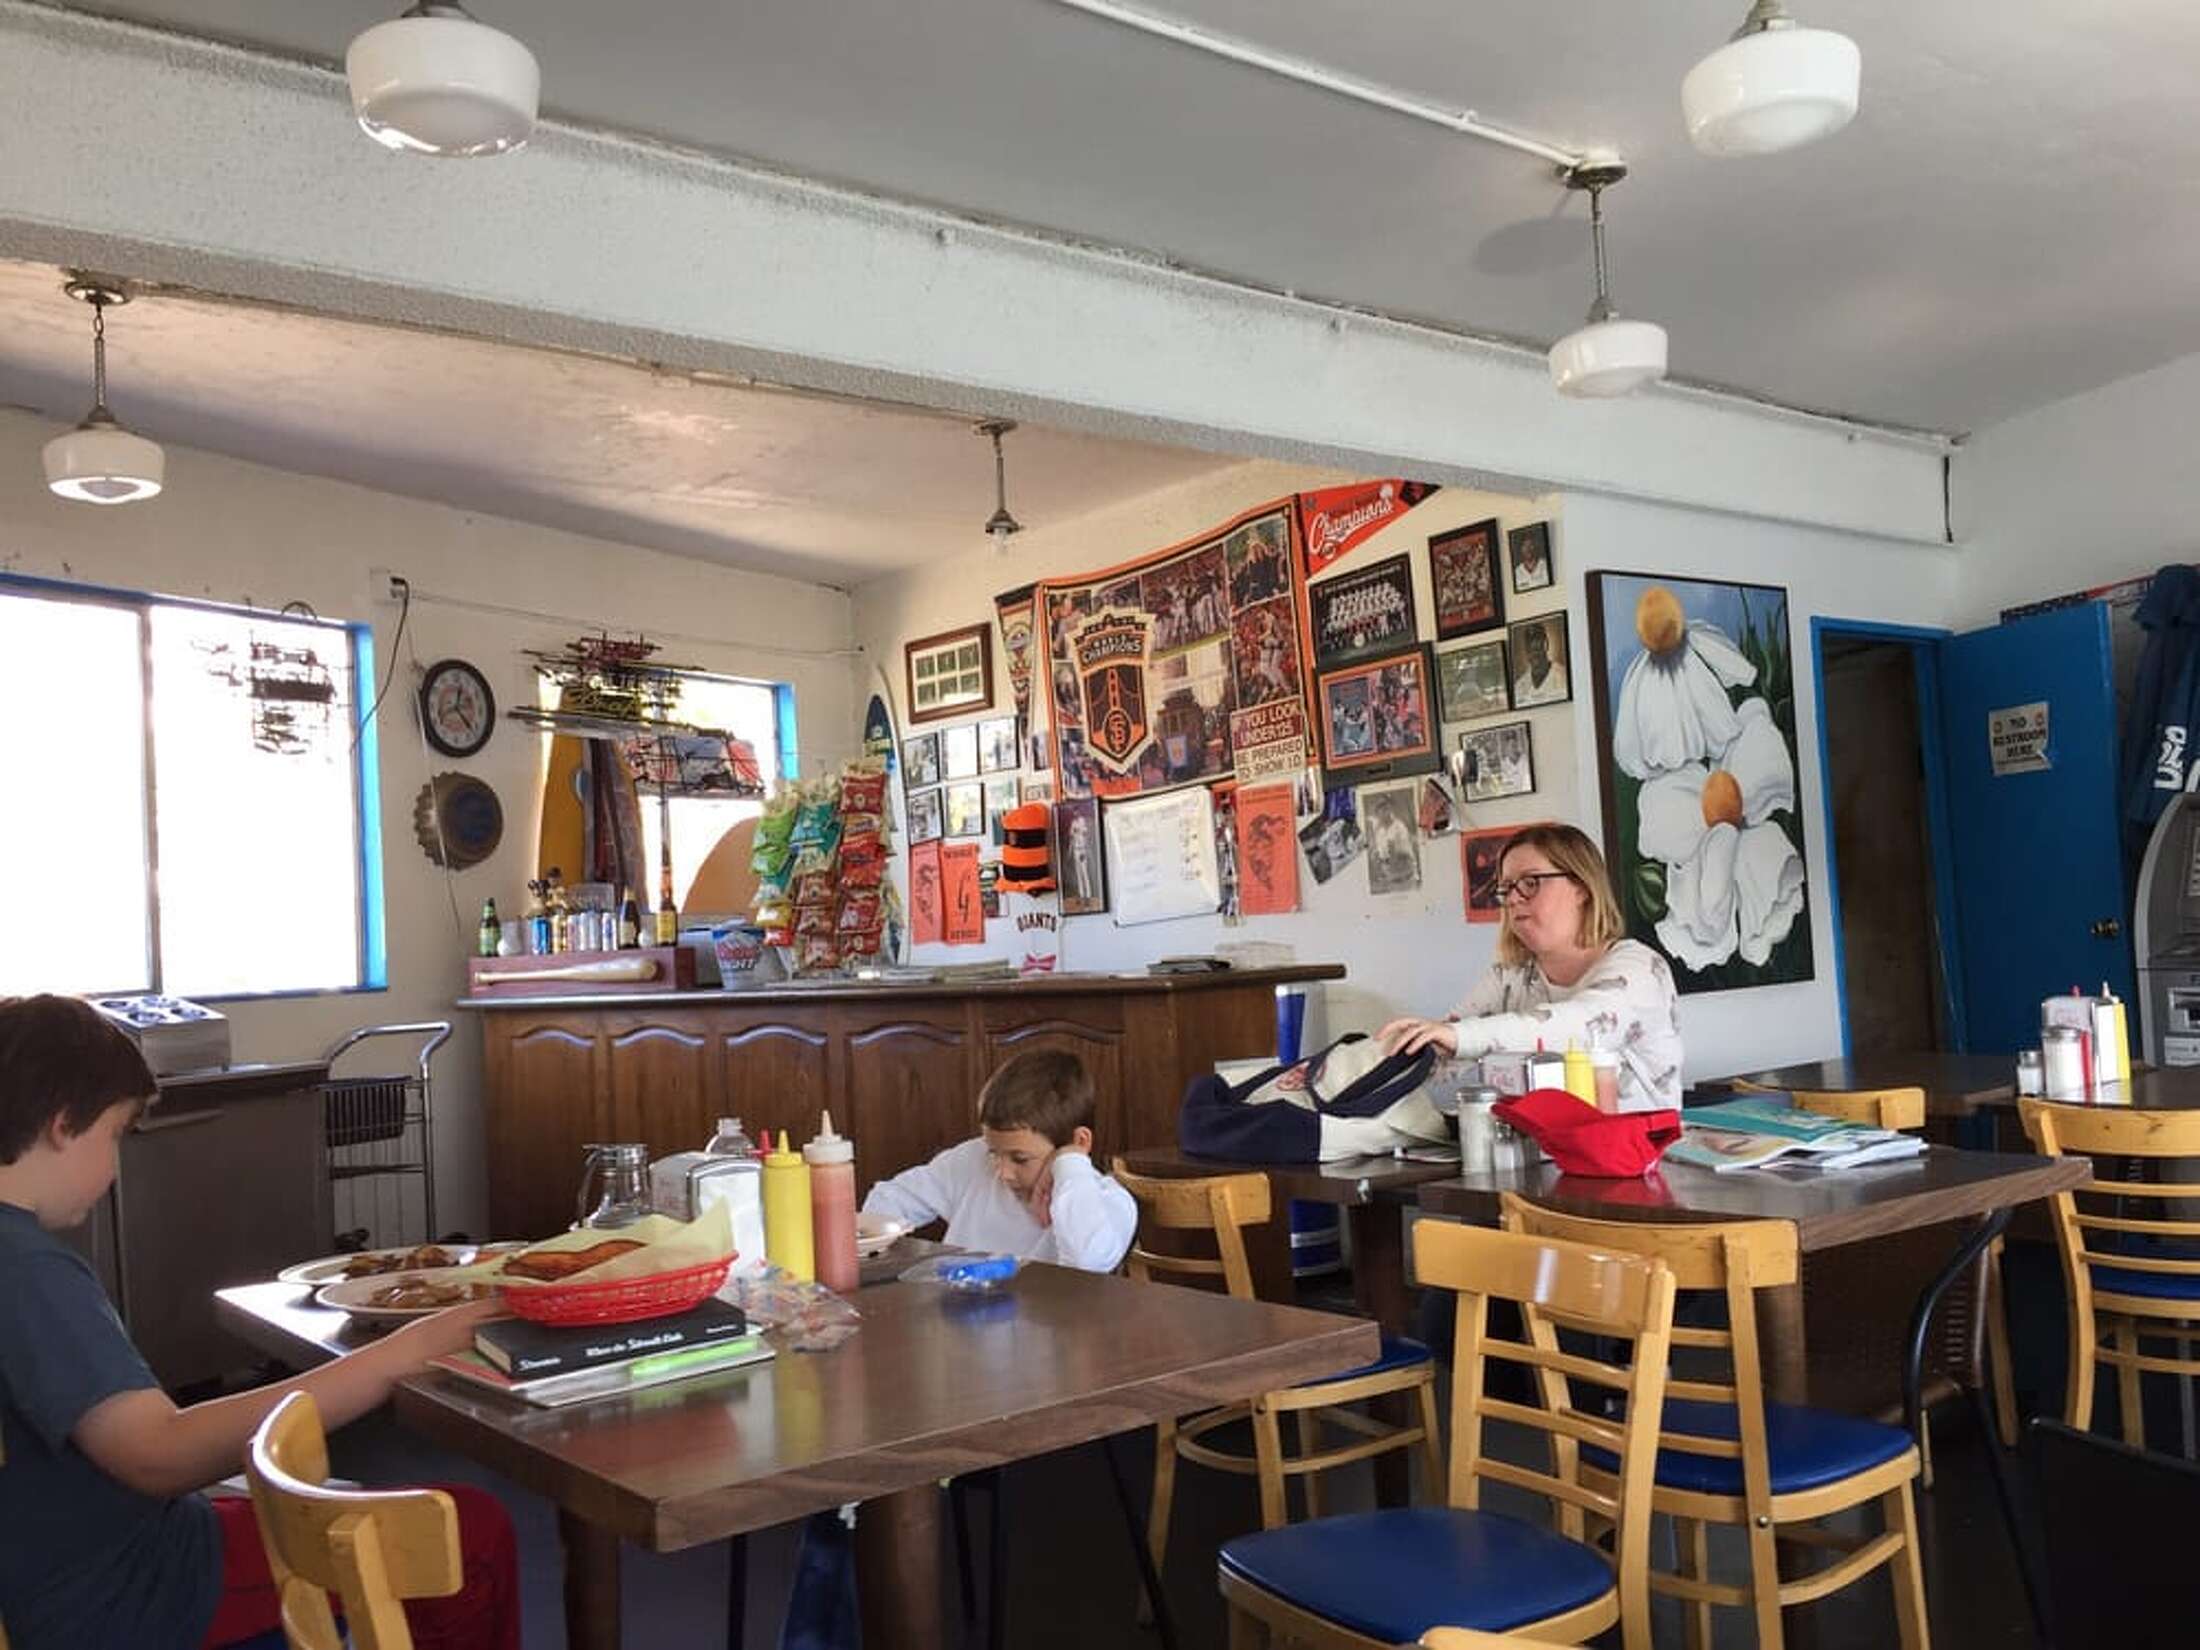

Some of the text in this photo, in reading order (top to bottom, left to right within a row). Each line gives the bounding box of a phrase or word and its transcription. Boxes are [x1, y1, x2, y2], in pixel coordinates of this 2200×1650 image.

[1308, 498, 1393, 556] Champions
[1246, 710, 1266, 728] YOU
[1269, 702, 1302, 723] LOOK
[1239, 724, 1277, 748] UNDER
[1251, 739, 1303, 763] PREPARED
[1017, 912, 1057, 933] GIANTS
